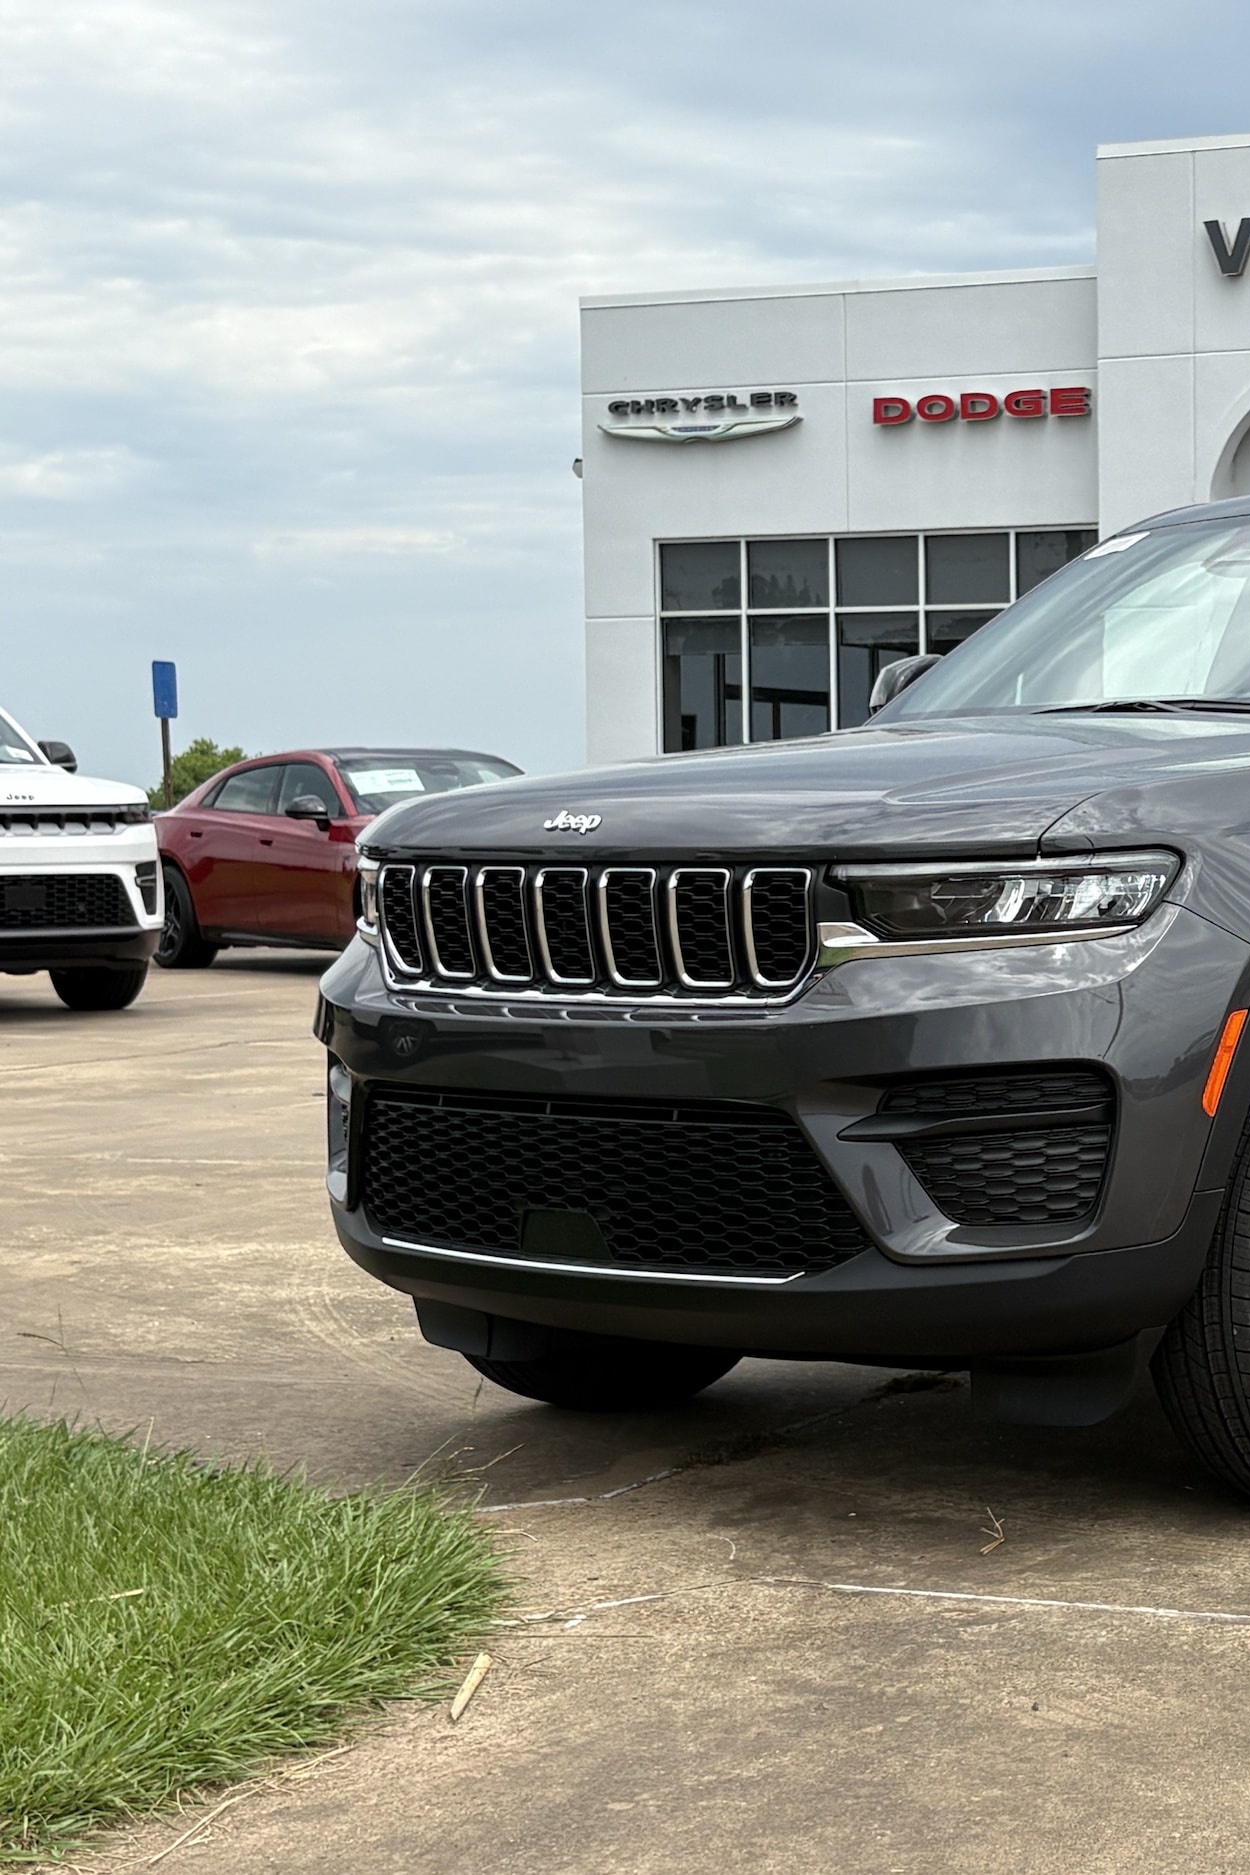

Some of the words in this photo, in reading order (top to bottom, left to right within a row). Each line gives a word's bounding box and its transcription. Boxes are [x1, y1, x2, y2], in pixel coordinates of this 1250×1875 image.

[608, 392, 799, 416] CHRYSLER
[872, 386, 1092, 427] DODGE
[543, 810, 602, 835] Jeep
